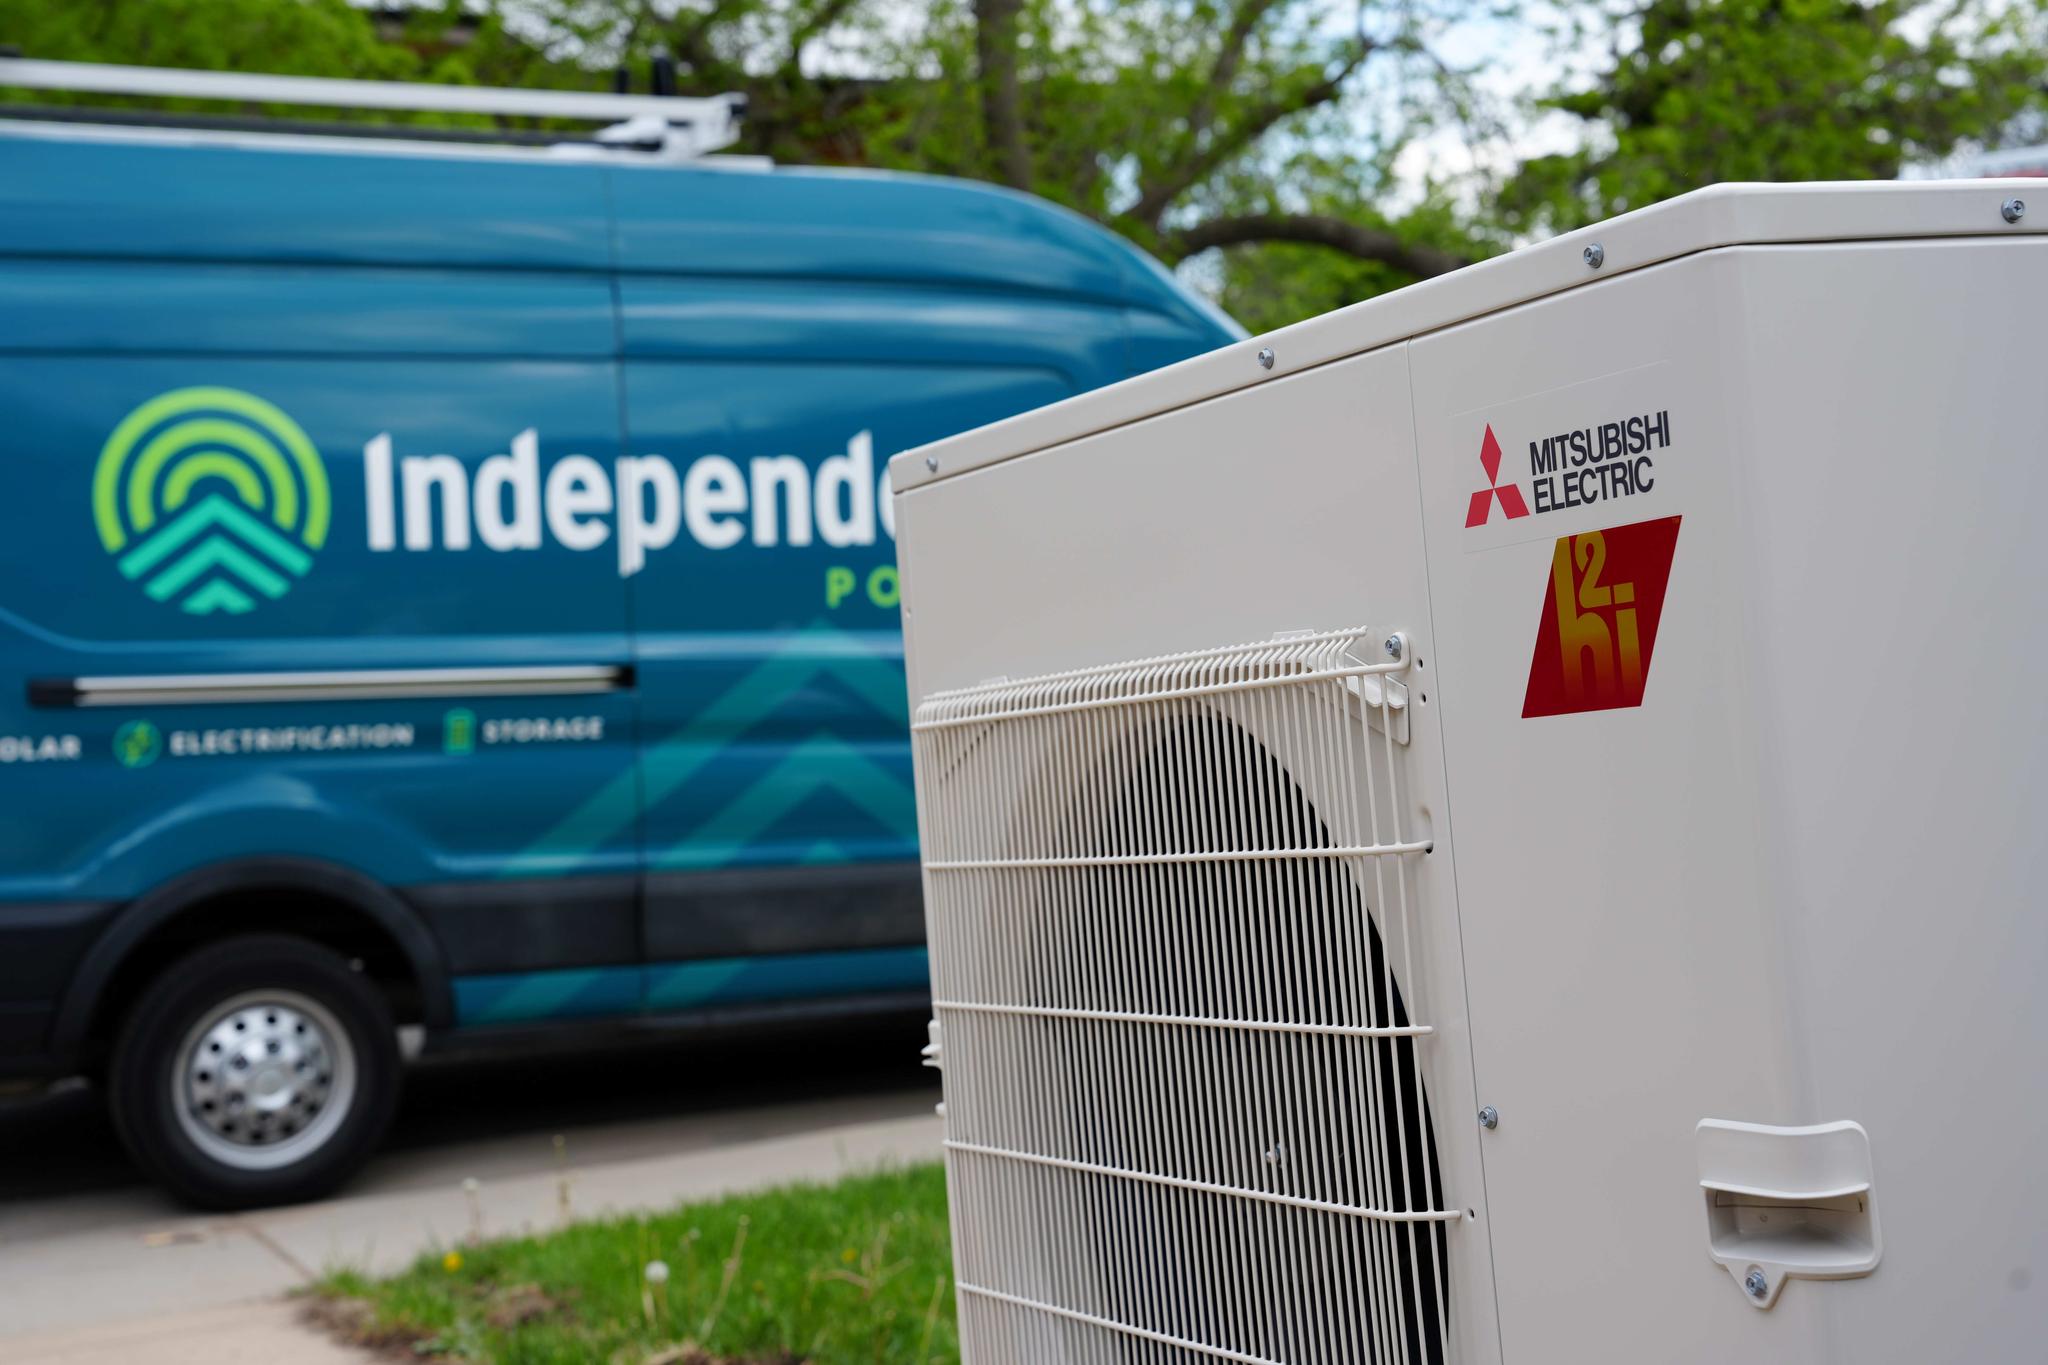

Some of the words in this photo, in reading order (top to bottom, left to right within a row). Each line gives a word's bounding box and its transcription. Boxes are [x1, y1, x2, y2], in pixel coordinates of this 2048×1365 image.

[1529, 410, 1671, 476] MITSUBISHI
[364, 427, 896, 577] Independ
[1532, 456, 1655, 515] ELECTRIC
[826, 565, 900, 609] PO
[170, 724, 414, 756] ELECTRIFICATION
[482, 715, 603, 742] STORAGE
